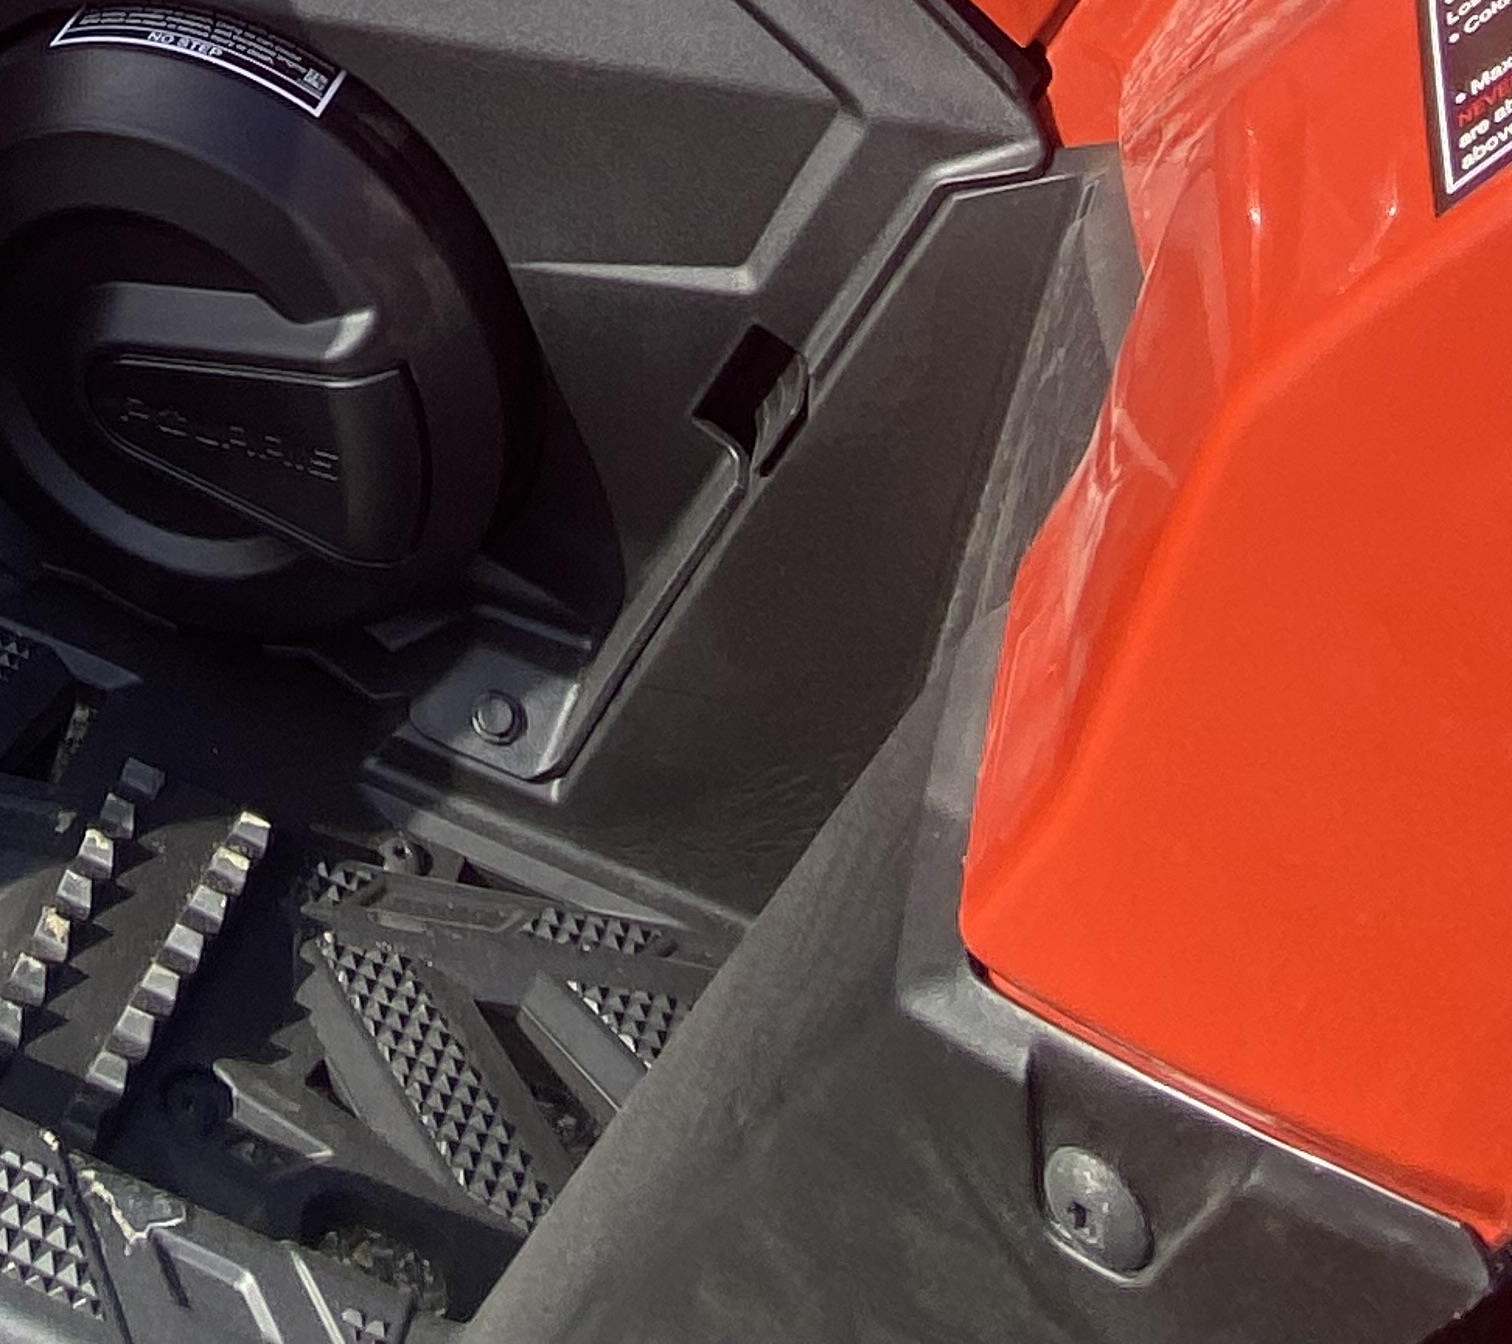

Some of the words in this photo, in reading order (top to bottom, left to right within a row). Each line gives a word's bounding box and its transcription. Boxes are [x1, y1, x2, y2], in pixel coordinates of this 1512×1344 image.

[148, 31, 175, 45] NO
[177, 36, 223, 57] STEP
[1459, 119, 1490, 149] are
